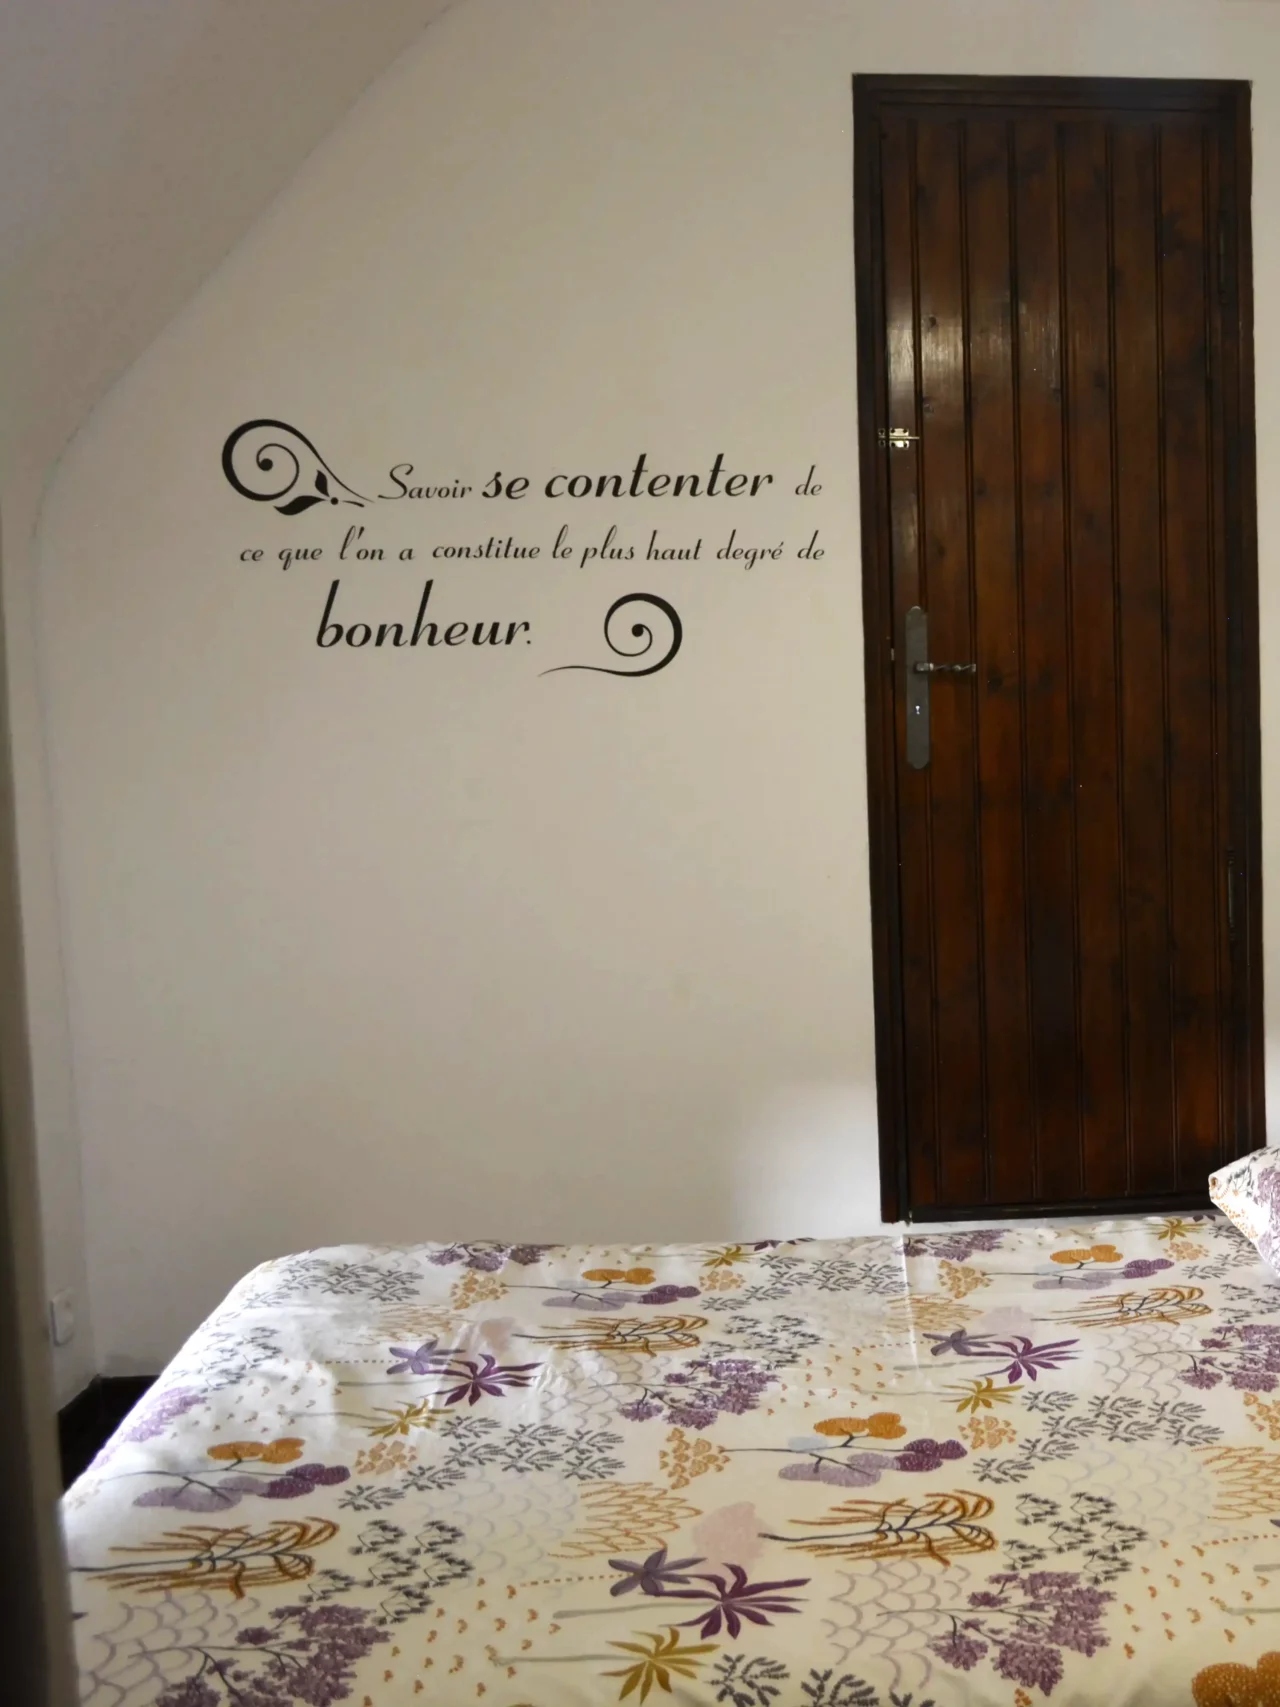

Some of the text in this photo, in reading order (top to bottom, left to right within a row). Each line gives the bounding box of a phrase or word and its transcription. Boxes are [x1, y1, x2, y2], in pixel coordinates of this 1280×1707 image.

[377, 453, 823, 500] Savoir se contenter de
[239, 525, 825, 571] ce que l'on a constitue le plus haut degré de
[316, 579, 533, 648] bonheur.
